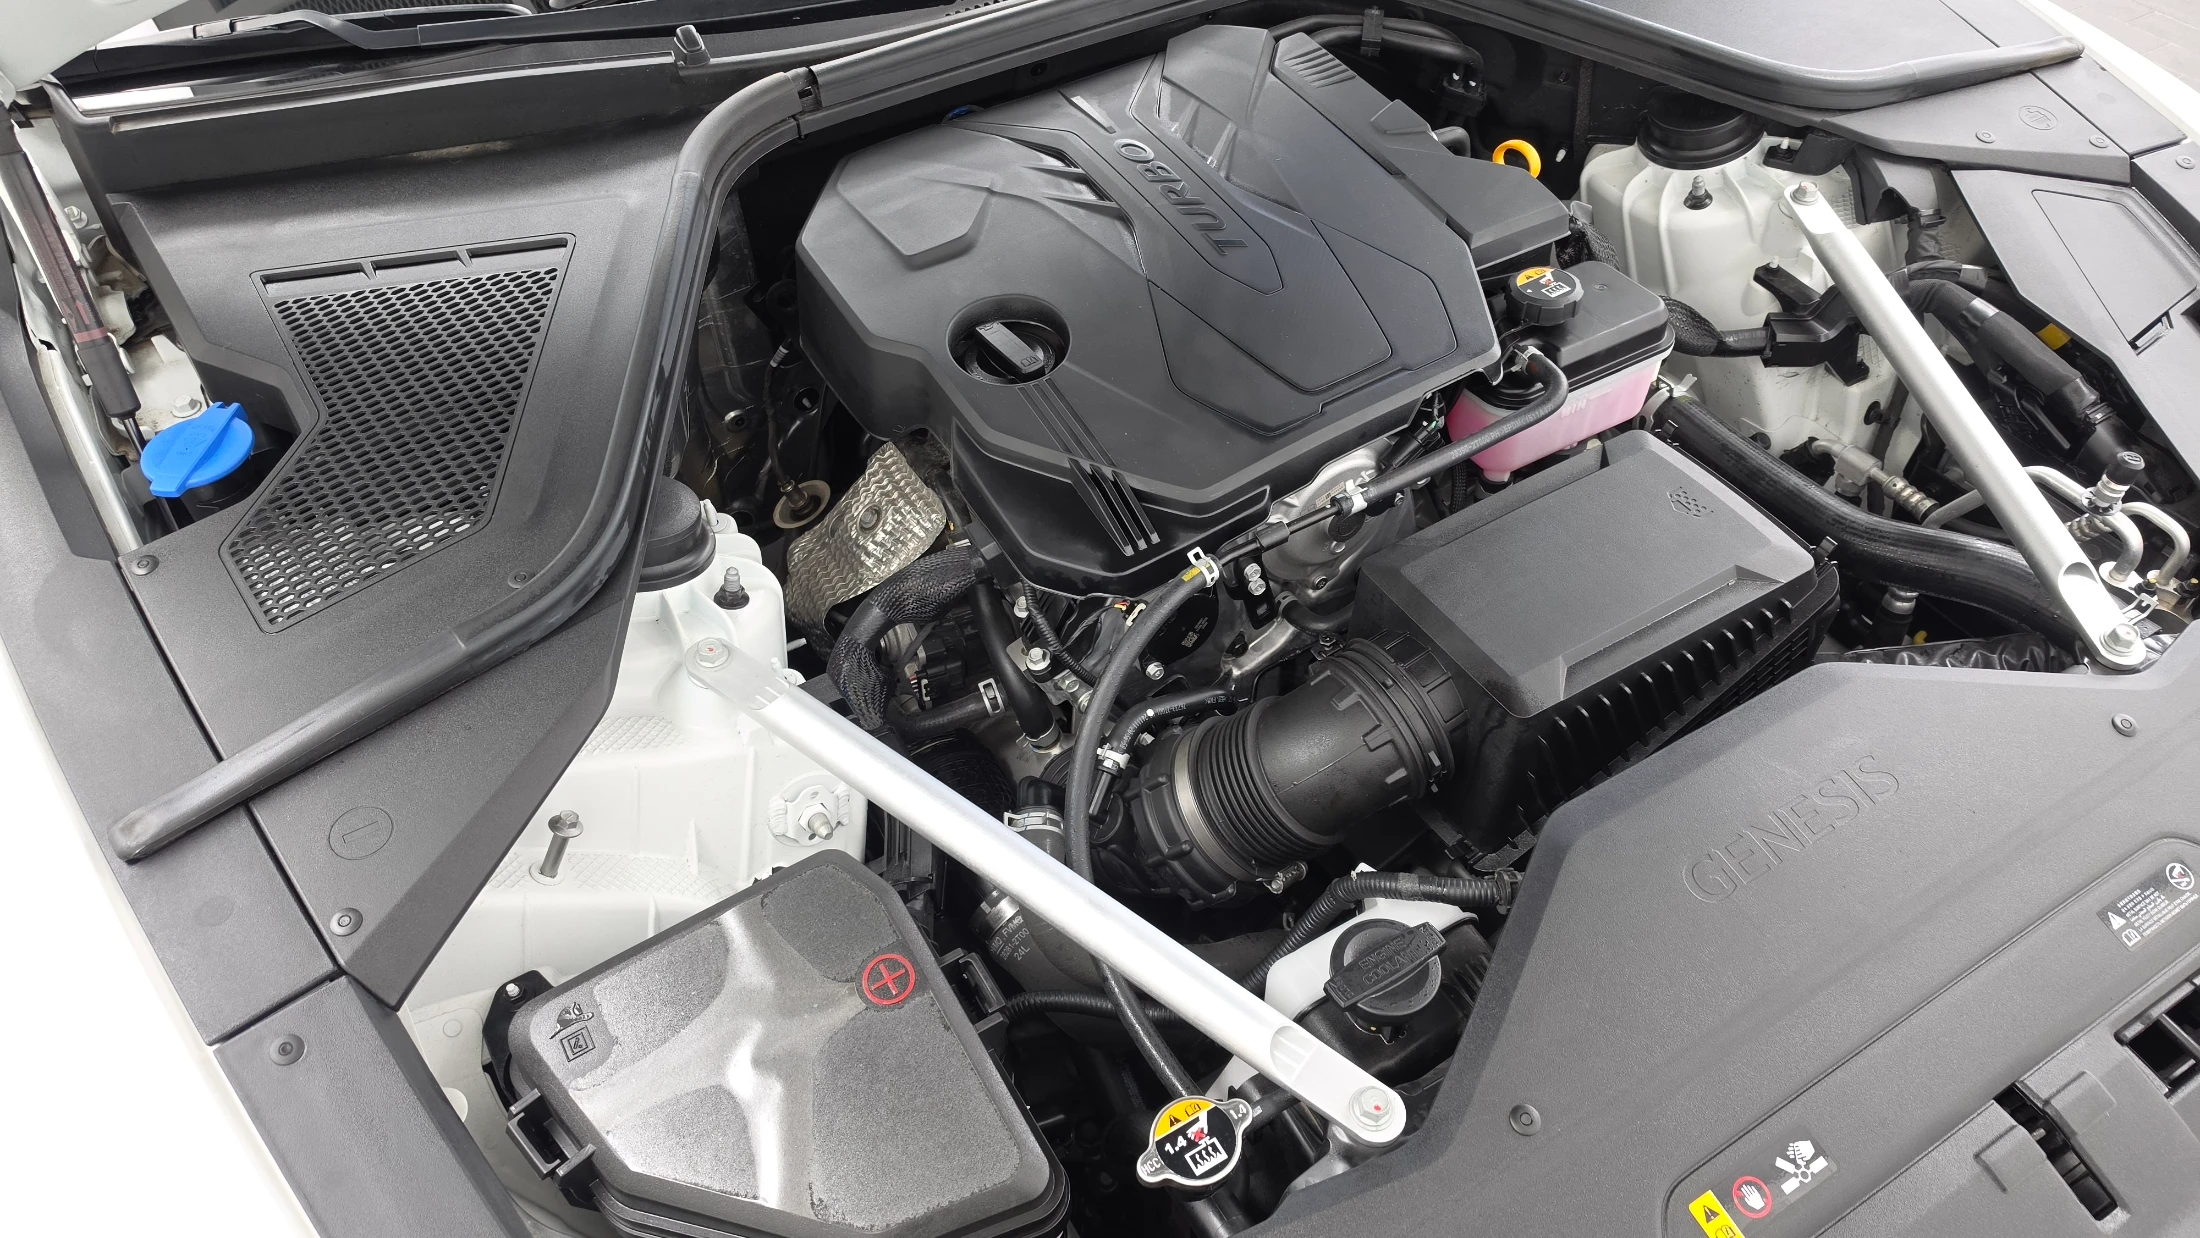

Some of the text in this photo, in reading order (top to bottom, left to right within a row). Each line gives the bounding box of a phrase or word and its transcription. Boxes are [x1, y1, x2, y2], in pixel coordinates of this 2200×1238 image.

[1113, 138, 1249, 256] TURBO
[1560, 398, 1588, 419] MIN
[1682, 754, 1900, 904] GENESIS
[1014, 945, 1031, 961] 24L
[1358, 936, 1407, 971] ENGINE
[1229, 1103, 1247, 1120] 1.4
[1164, 1134, 1188, 1156] 1.4
[1140, 1157, 1161, 1176] HCC
